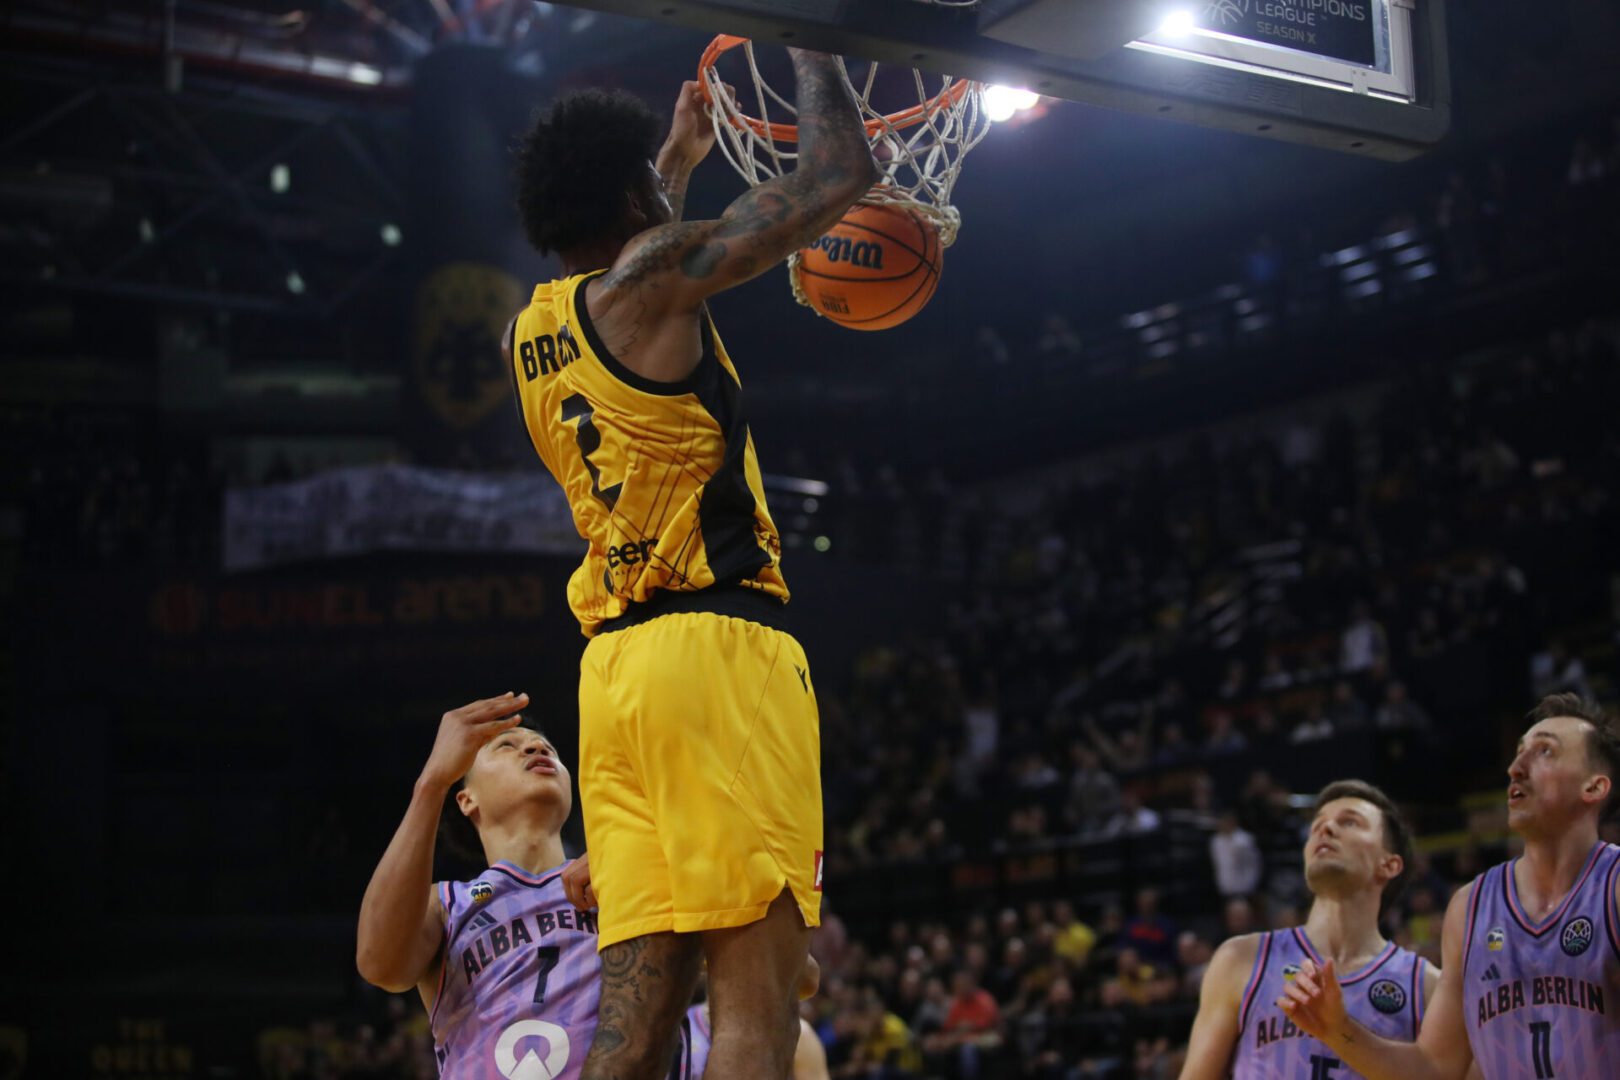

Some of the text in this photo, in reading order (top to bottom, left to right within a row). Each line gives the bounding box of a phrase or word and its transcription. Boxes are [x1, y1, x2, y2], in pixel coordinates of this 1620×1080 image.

[1255, 2, 1316, 26] LEAGUE
[1256, 21, 1317, 45] SEASON X
[810, 236, 883, 270] Wilso
[462, 909, 599, 985] ALBA BER
[532, 946, 560, 1003] 7
[1478, 976, 1605, 1028] ALBA BERLIN
[1257, 1017, 1315, 1048] ALB
[1529, 1021, 1555, 1080] 11
